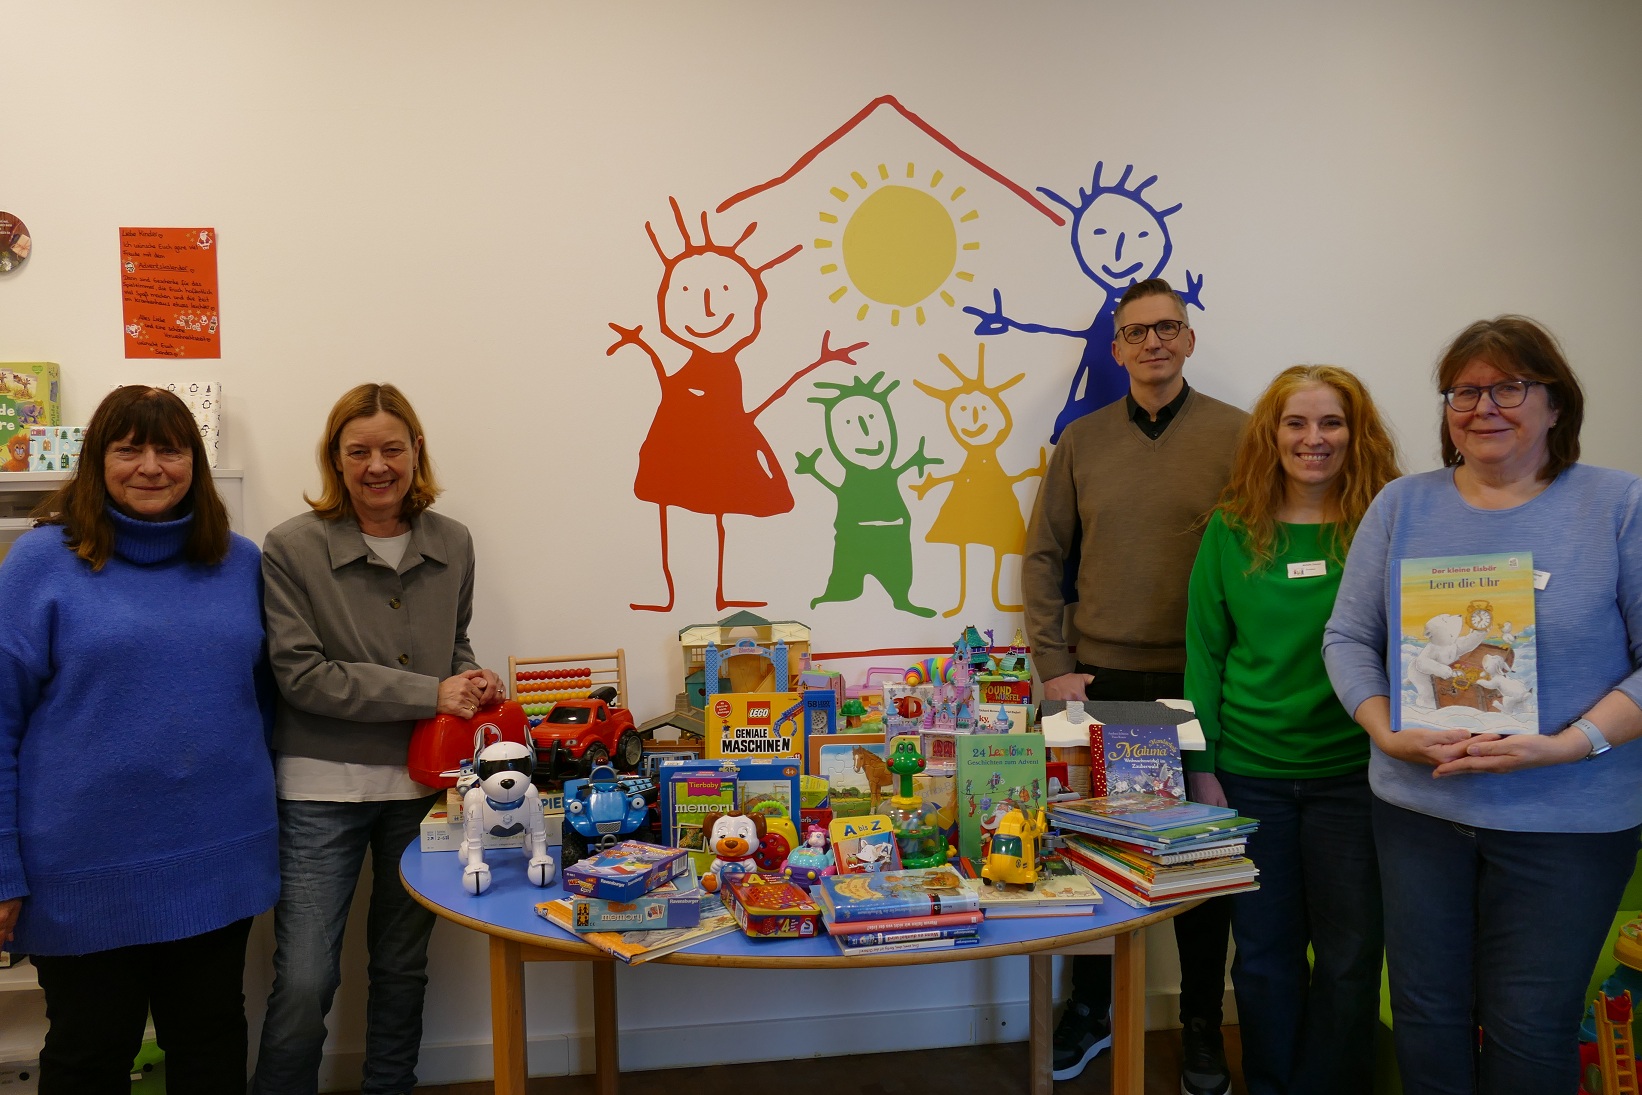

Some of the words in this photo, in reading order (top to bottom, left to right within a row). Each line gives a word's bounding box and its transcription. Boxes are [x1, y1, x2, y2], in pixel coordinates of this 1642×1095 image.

[1430, 580, 1454, 589] Lern
[1458, 578, 1475, 588] die
[1480, 577, 1500, 587] Uhr
[749, 708, 768, 717] LEGO
[736, 728, 767, 738] GENIALE
[722, 738, 790, 753] MASCHINEN
[1108, 742, 1167, 760] Maluna
[973, 749, 986, 757] 24
[675, 803, 734, 813] memory
[844, 824, 857, 836] A
[870, 820, 881, 831] Z
[881, 846, 889, 854] A
[748, 873, 766, 885] 4
[602, 913, 643, 923] memory
[781, 918, 790, 932] 4
